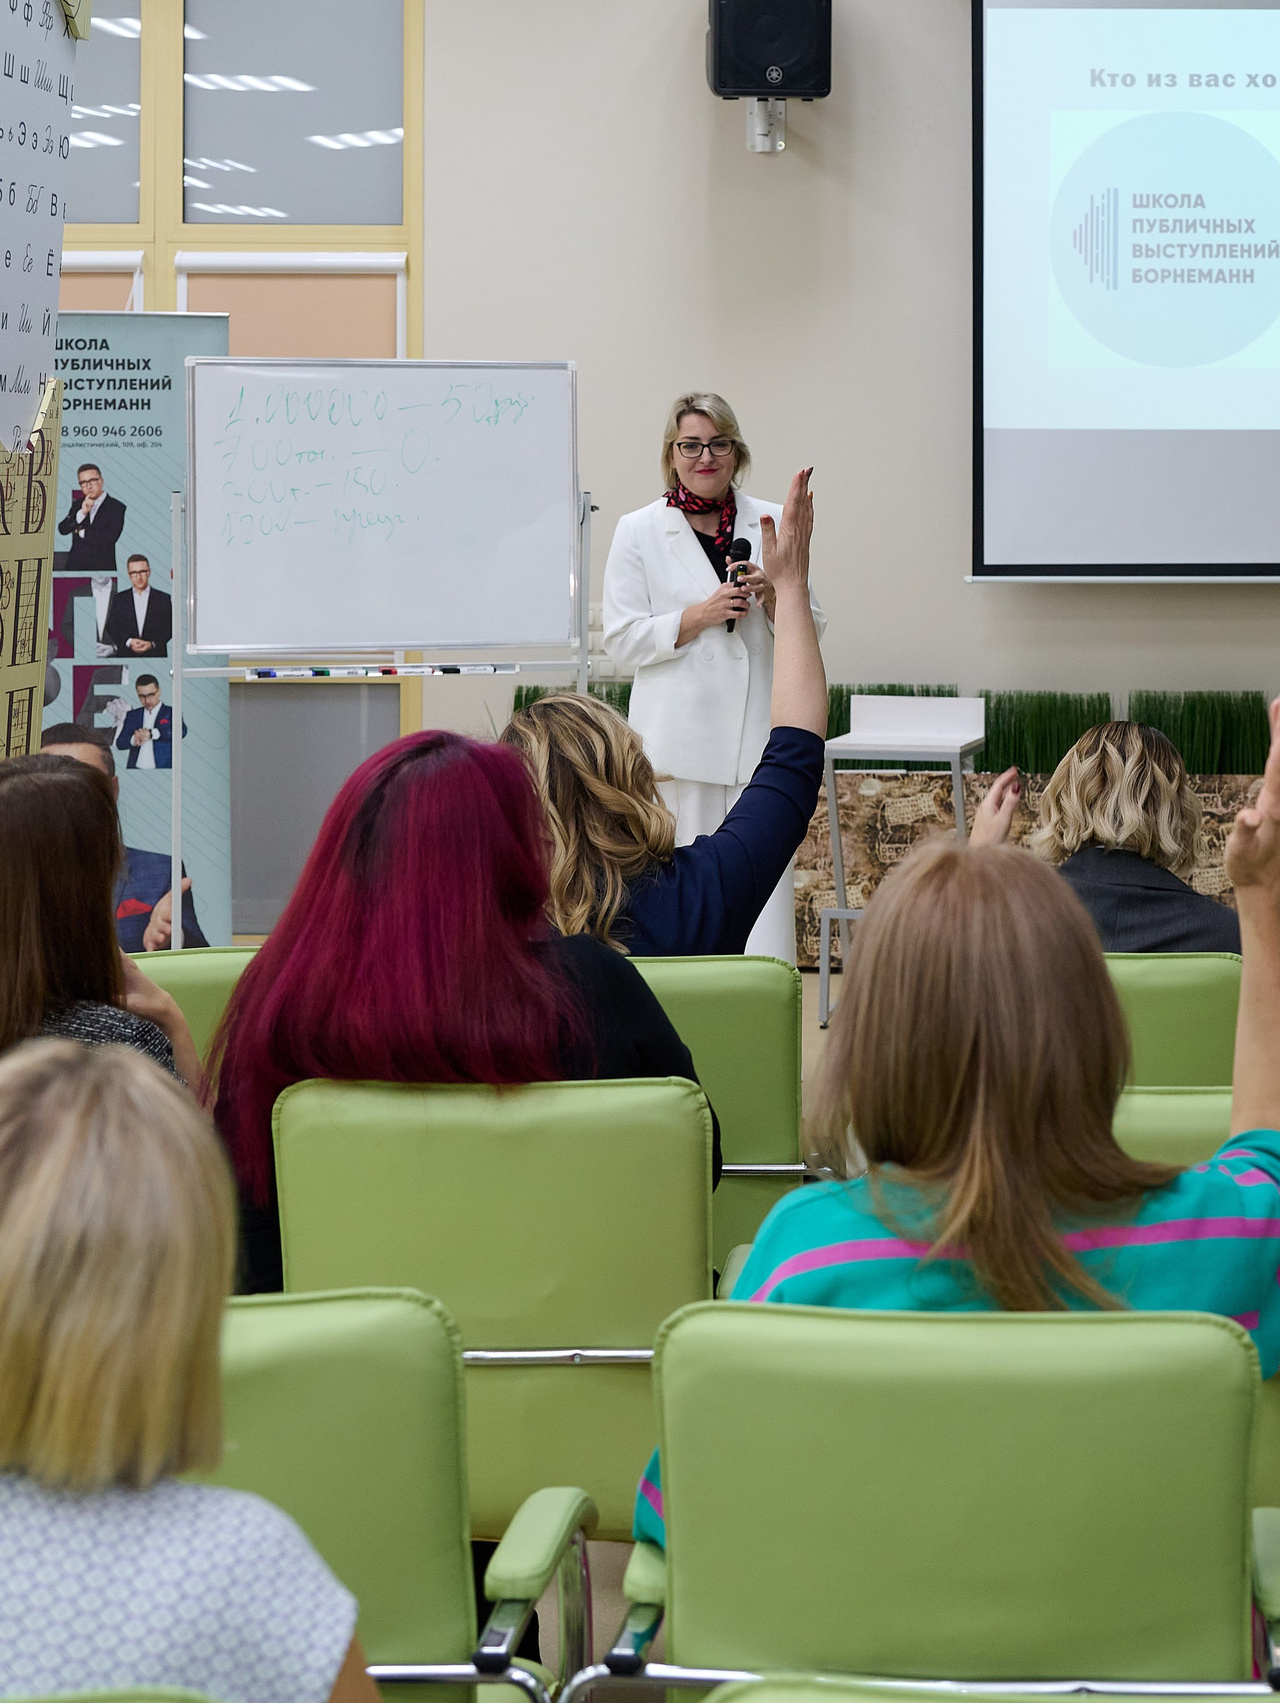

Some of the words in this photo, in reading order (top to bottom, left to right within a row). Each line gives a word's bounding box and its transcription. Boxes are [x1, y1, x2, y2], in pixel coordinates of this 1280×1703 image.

[1090, 68, 1136, 88] Кто
[1147, 73, 1178, 88] из
[1188, 73, 1236, 88] вас
[1132, 193, 1206, 209] ШКОЛА
[1131, 218, 1256, 234] ПУБЛИЧНЫХ
[1131, 240, 1280, 259] ВЫСТУПЛЕНИЙ
[1131, 268, 1255, 284] БОРНЕМАНН
[63, 375, 172, 391] ЫСТУПЛЕНИЙ
[62, 398, 151, 411] ОРНЕМАНН
[61, 425, 69, 437] 8
[73, 425, 98, 437] 960
[102, 425, 127, 437] 946
[130, 425, 163, 437] 2606
